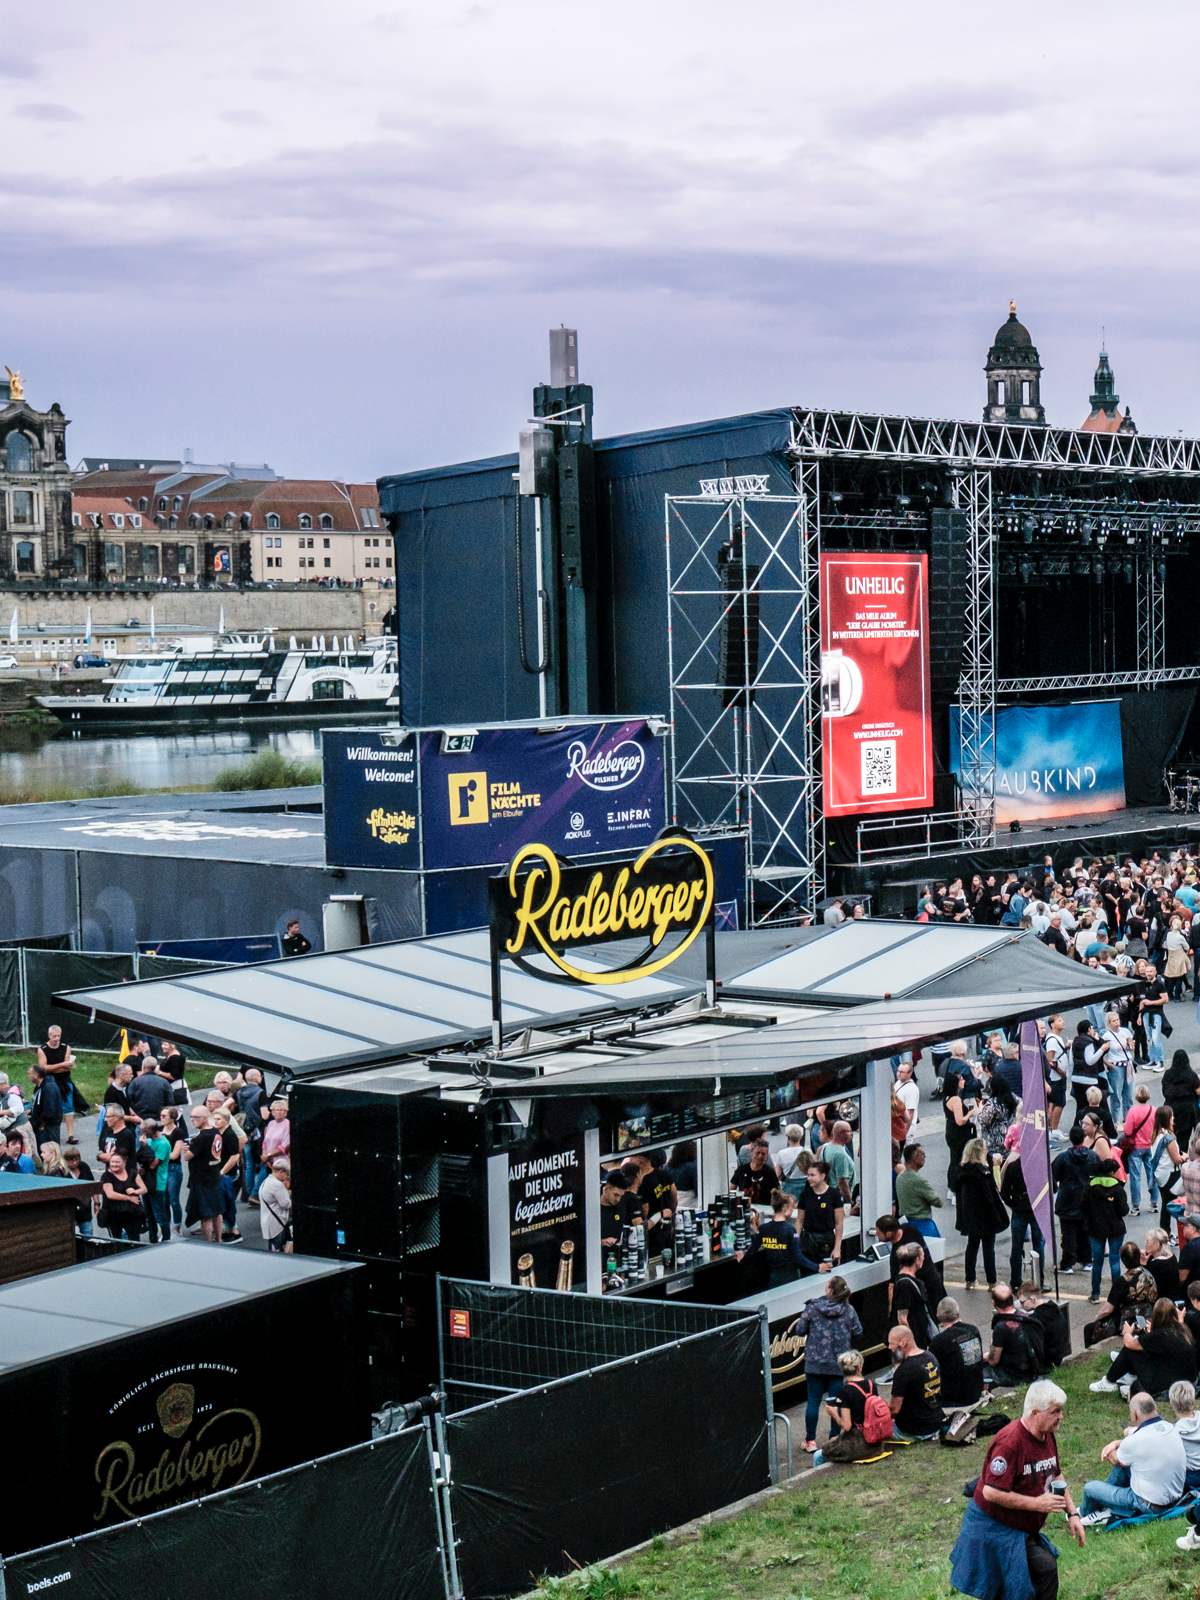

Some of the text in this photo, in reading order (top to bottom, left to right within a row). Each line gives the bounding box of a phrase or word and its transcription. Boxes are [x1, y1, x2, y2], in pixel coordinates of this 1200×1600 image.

[845, 576, 905, 595] UNHEILIG
[347, 747, 413, 762] Willkommen!
[567, 741, 643, 780] Radeberger
[365, 768, 414, 783] Welcome!
[490, 782, 521, 796] FILM
[491, 794, 541, 810] NÄCHTE
[506, 843, 704, 953] Radeberger
[508, 1150, 579, 1182] AUF MOMENTE,
[525, 1174, 563, 1198] DIE UNS
[515, 1193, 574, 1223] begeistern
[108, 1381, 148, 1415] KÖNIGLICH
[137, 1422, 155, 1433] SEIT
[93, 1441, 253, 1520] Radeberger
[27, 1571, 71, 1593] boels.com
